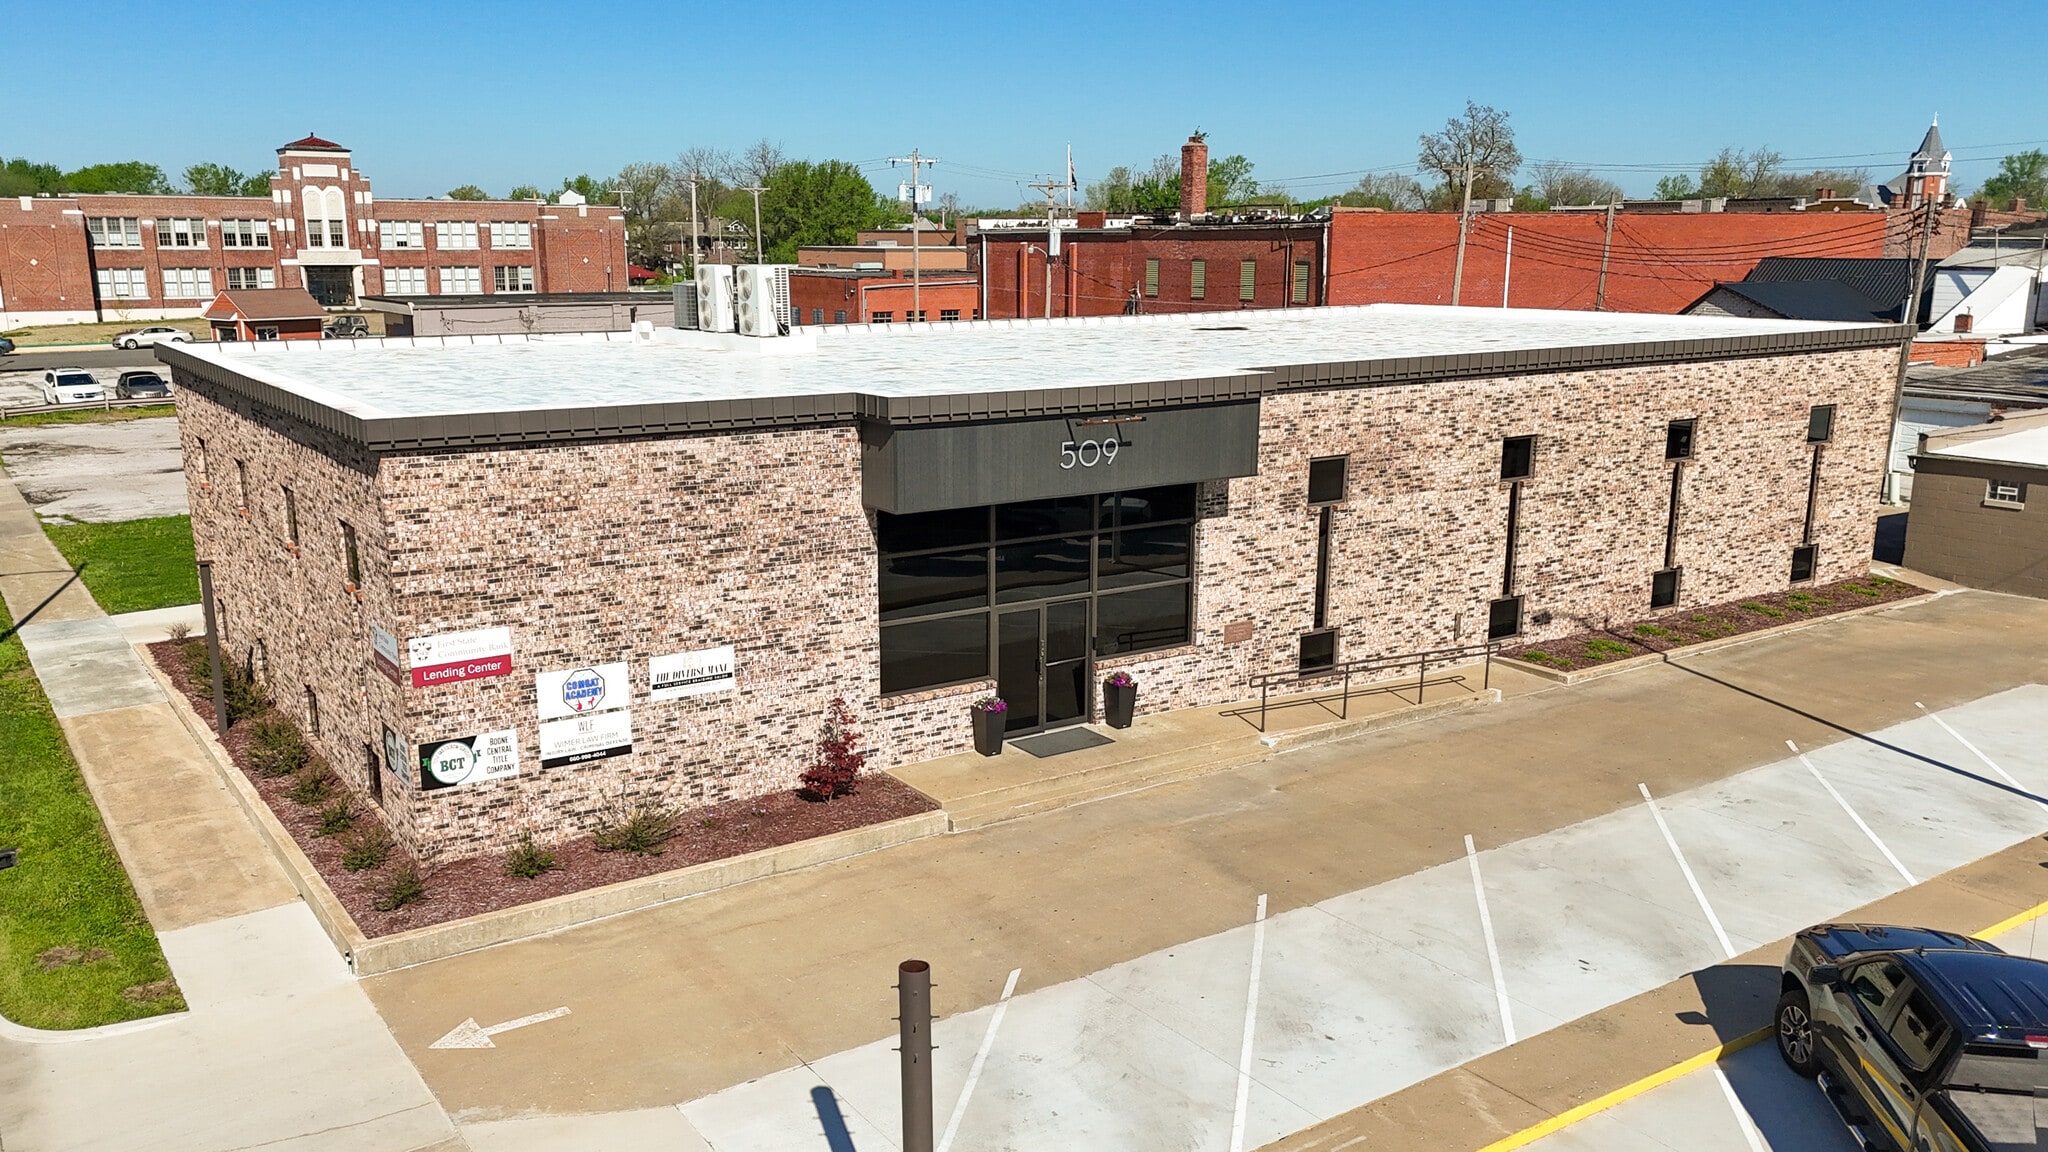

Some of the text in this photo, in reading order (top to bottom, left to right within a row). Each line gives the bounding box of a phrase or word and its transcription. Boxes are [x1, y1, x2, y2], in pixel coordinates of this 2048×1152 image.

[1059, 437, 1119, 469] 509
[438, 637, 477, 648] First State
[438, 646, 487, 658] Community
[489, 642, 508, 652] Bank
[423, 662, 502, 680] Lending Center
[566, 678, 599, 690] COMBAT
[565, 687, 602, 700] ACADEMY
[578, 720, 594, 731] WLF
[554, 732, 619, 748] WIMER LAW FIRM
[486, 745, 512, 755] CENTRAL
[440, 757, 465, 772] BCT
[492, 755, 508, 764] TITLE
[486, 763, 515, 774] COMPANY
